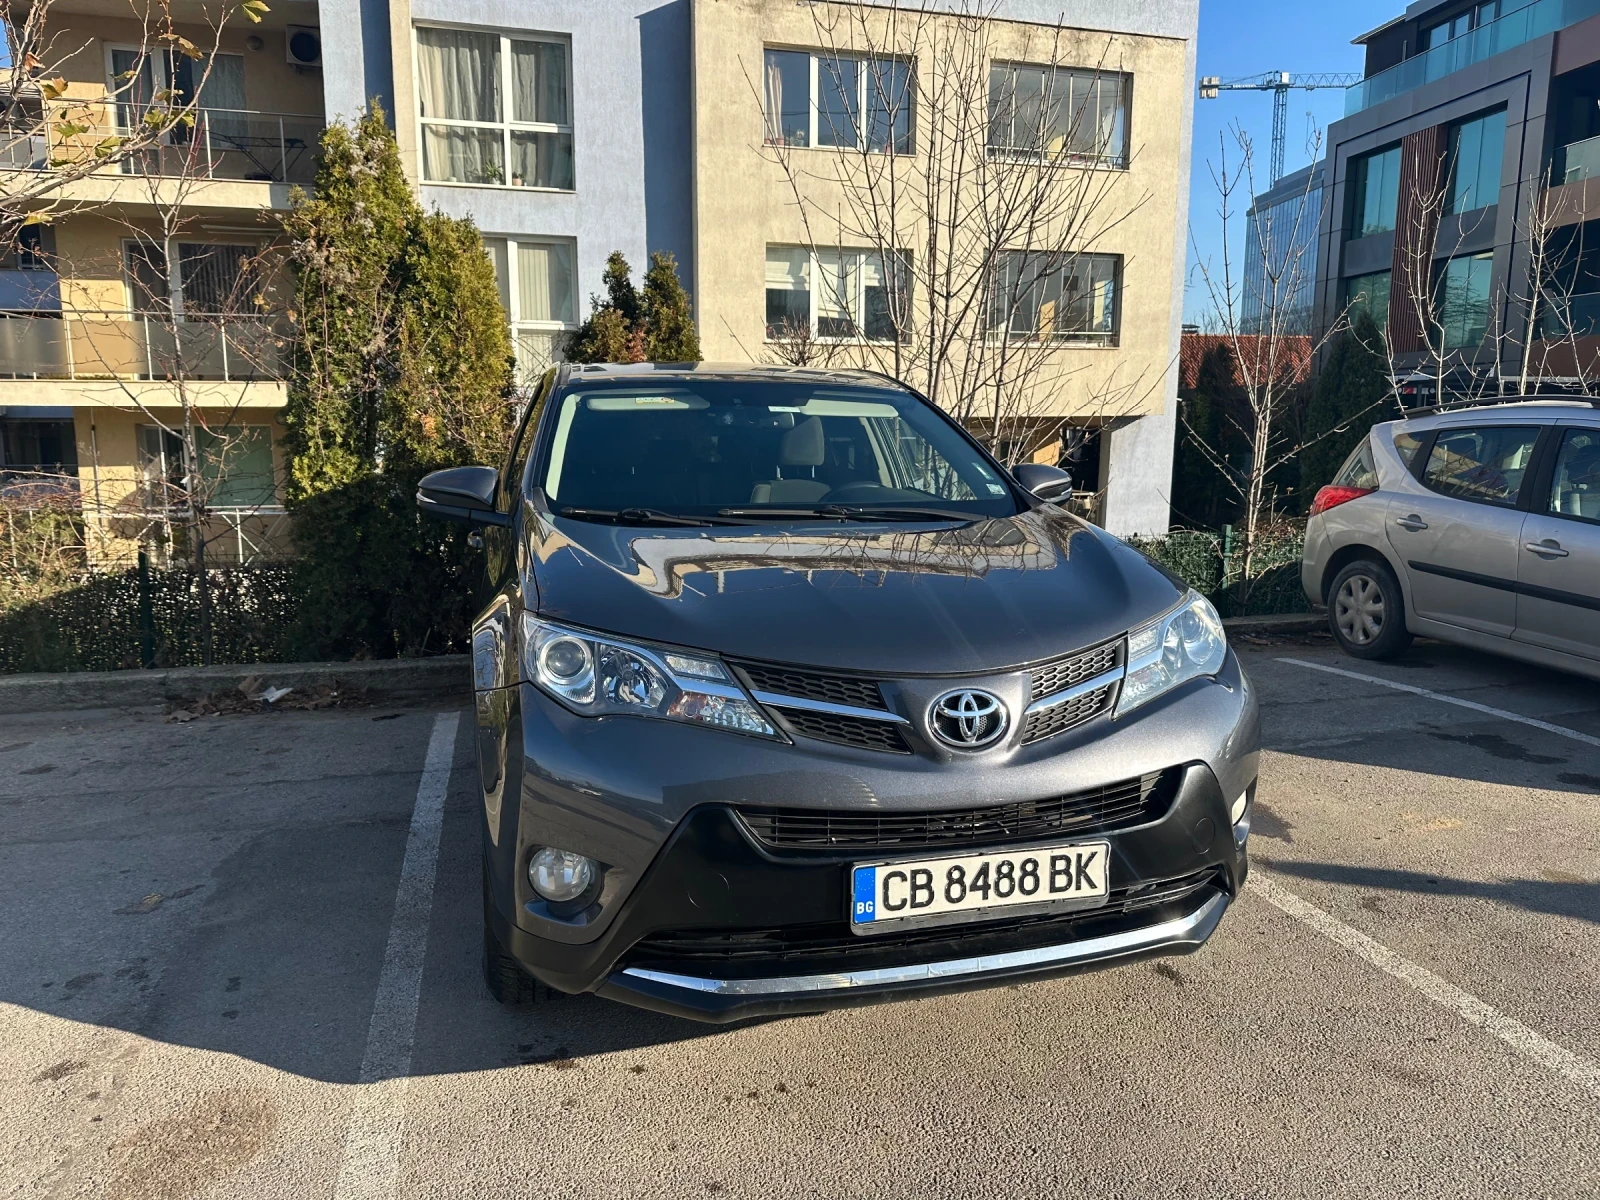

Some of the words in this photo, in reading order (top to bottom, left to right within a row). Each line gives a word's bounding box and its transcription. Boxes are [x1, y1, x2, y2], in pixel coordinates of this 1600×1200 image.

[883, 868, 935, 911] CB
[944, 857, 1040, 904] 8488
[1049, 851, 1098, 893] BK
[857, 901, 874, 914] BG
